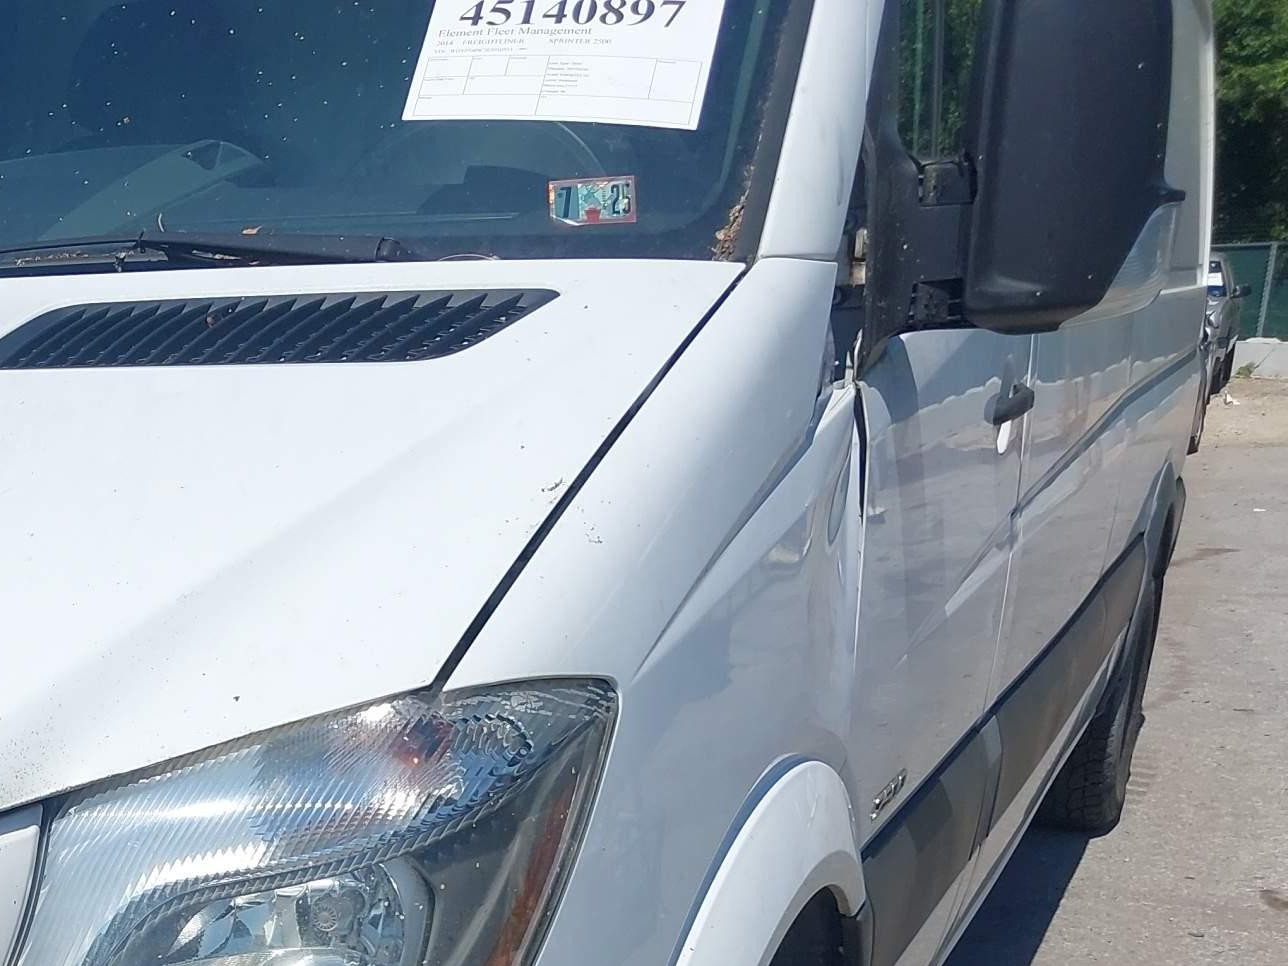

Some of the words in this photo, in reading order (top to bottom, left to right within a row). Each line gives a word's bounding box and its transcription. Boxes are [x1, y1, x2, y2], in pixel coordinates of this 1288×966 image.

[459, 0, 686, 27] 45140897
[438, 29, 483, 37] Element
[487, 28, 514, 36] Fleet
[518, 27, 592, 36] Management
[462, 38, 525, 46] FREIGHTLINER
